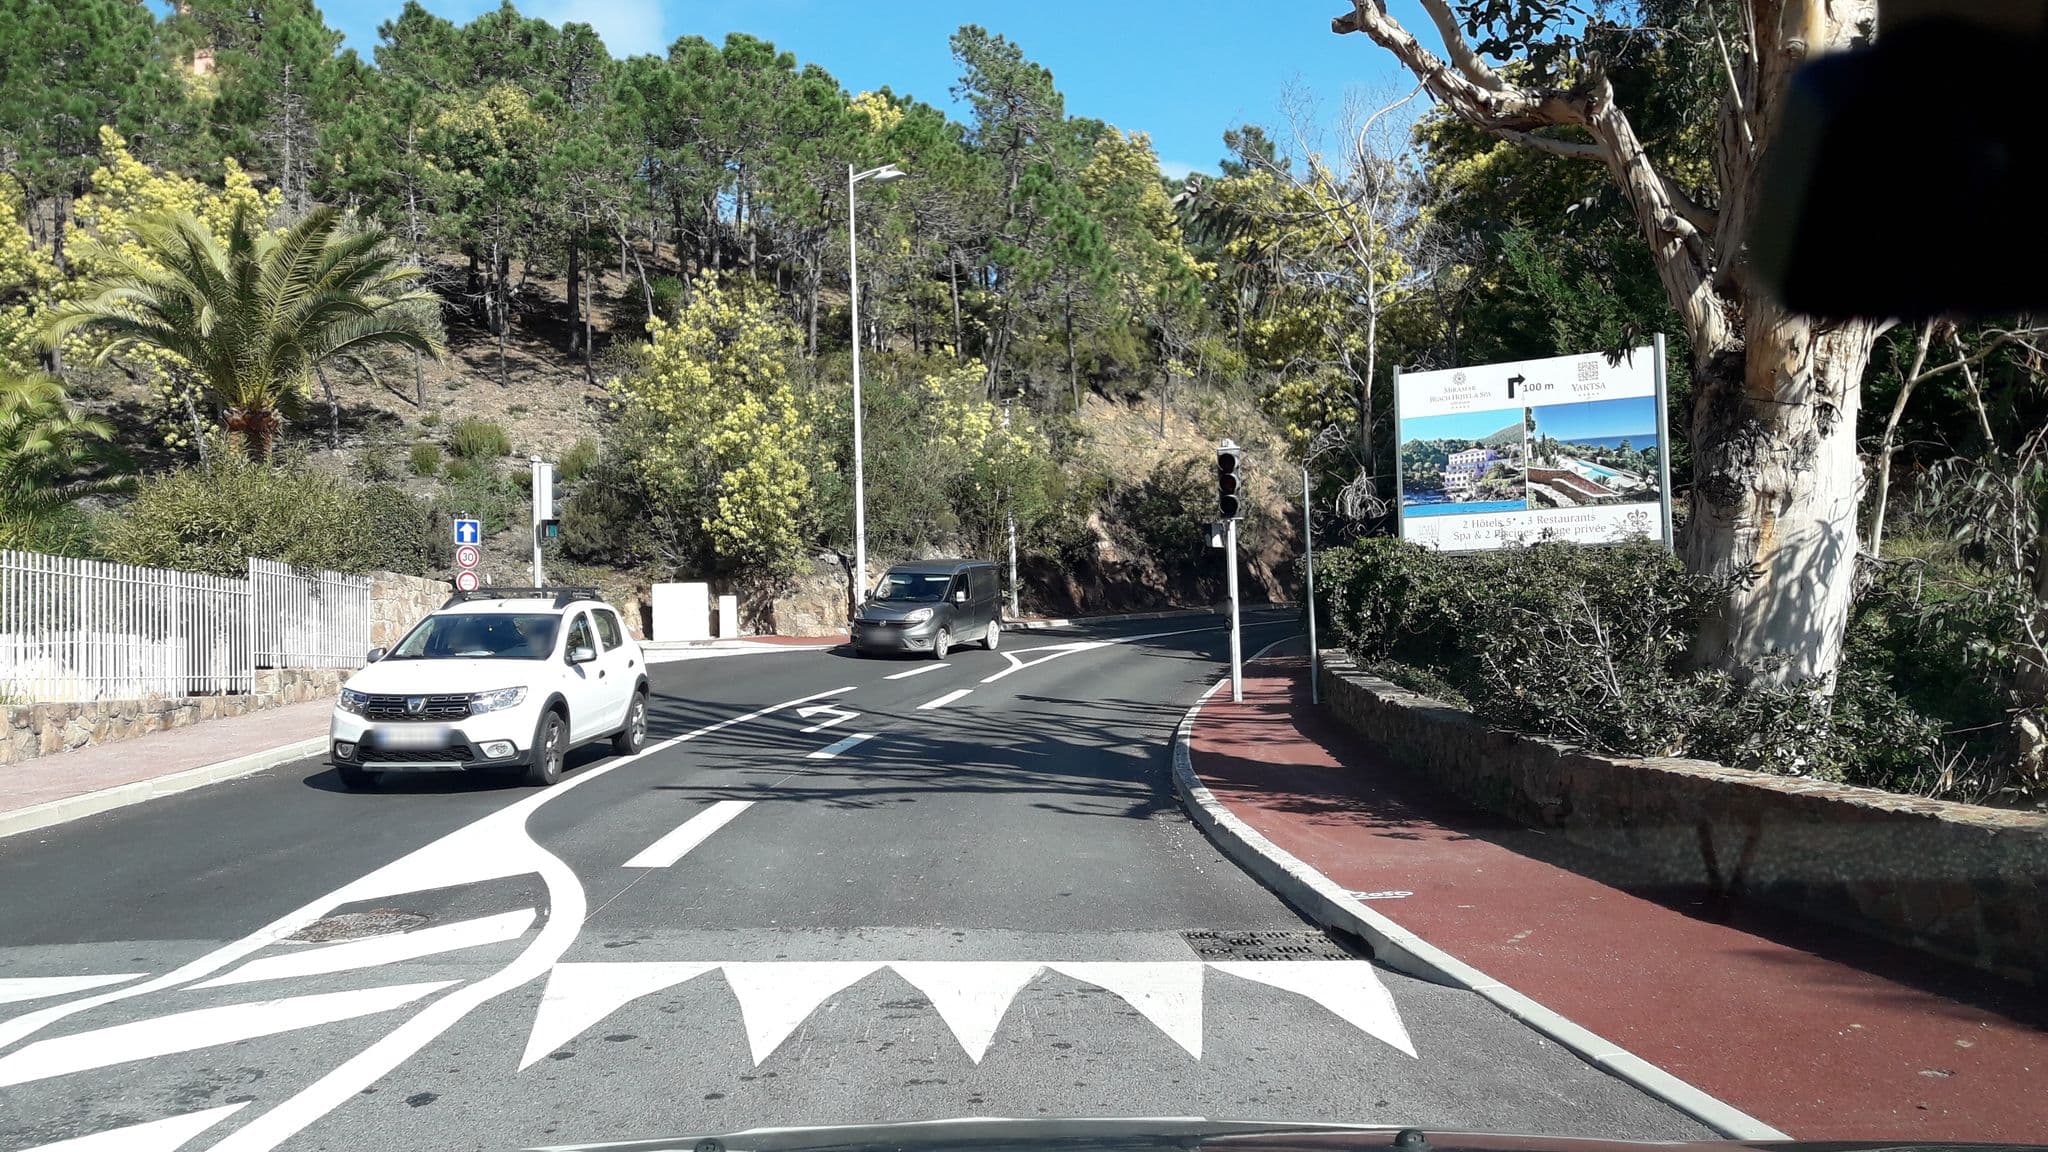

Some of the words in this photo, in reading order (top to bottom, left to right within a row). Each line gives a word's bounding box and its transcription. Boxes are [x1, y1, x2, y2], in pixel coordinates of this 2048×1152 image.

[1523, 383, 1541, 392] 100
[1463, 520, 1468, 528] 2
[1472, 517, 1503, 528] Hôtels
[1528, 516, 1533, 525] 3
[1537, 514, 1596, 525] Restaurants
[1453, 531, 1471, 542] Spa
[1475, 530, 1481, 539] &
[1485, 530, 1491, 538] 2
[1544, 525, 1571, 536] age
[1574, 523, 1607, 536] privée
[462, 552, 474, 562] 30
